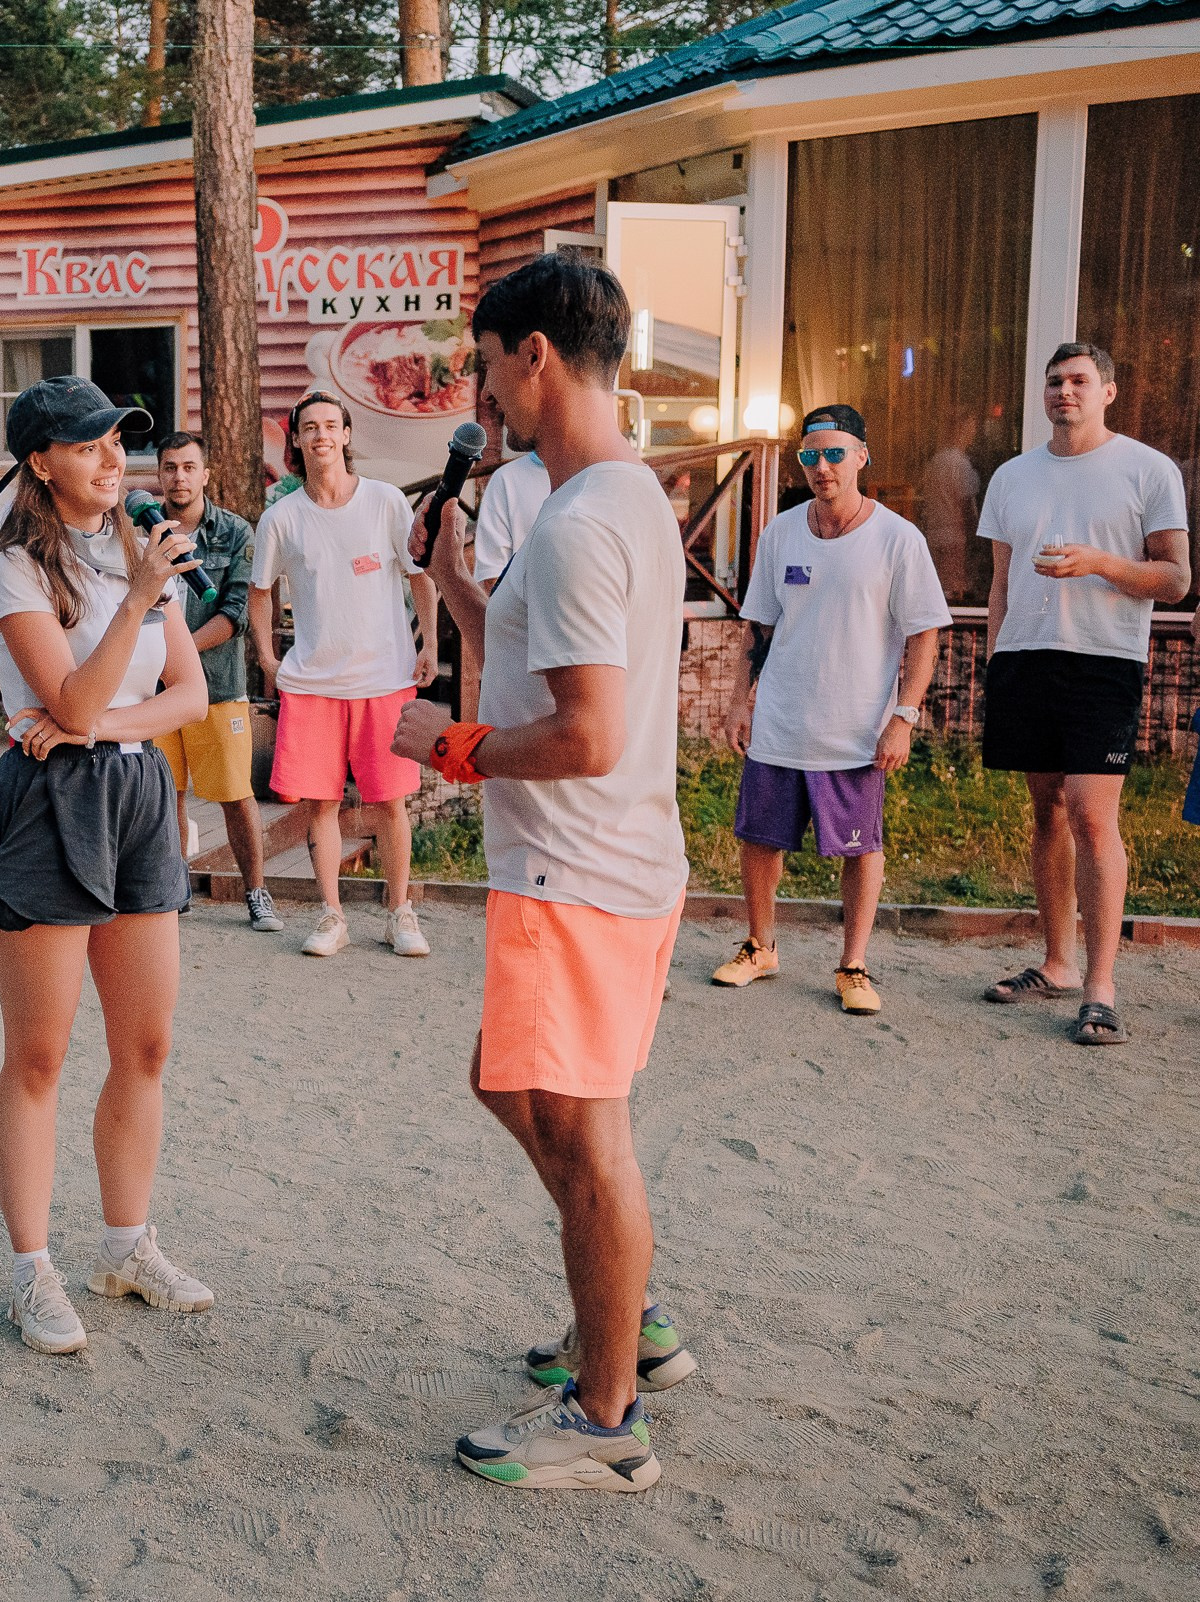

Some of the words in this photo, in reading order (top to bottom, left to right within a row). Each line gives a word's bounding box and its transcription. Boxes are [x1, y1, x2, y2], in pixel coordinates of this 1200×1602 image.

[22, 246, 147, 296] Квас
[321, 292, 453, 320] кухня
[1104, 752, 1129, 764] NIKE
